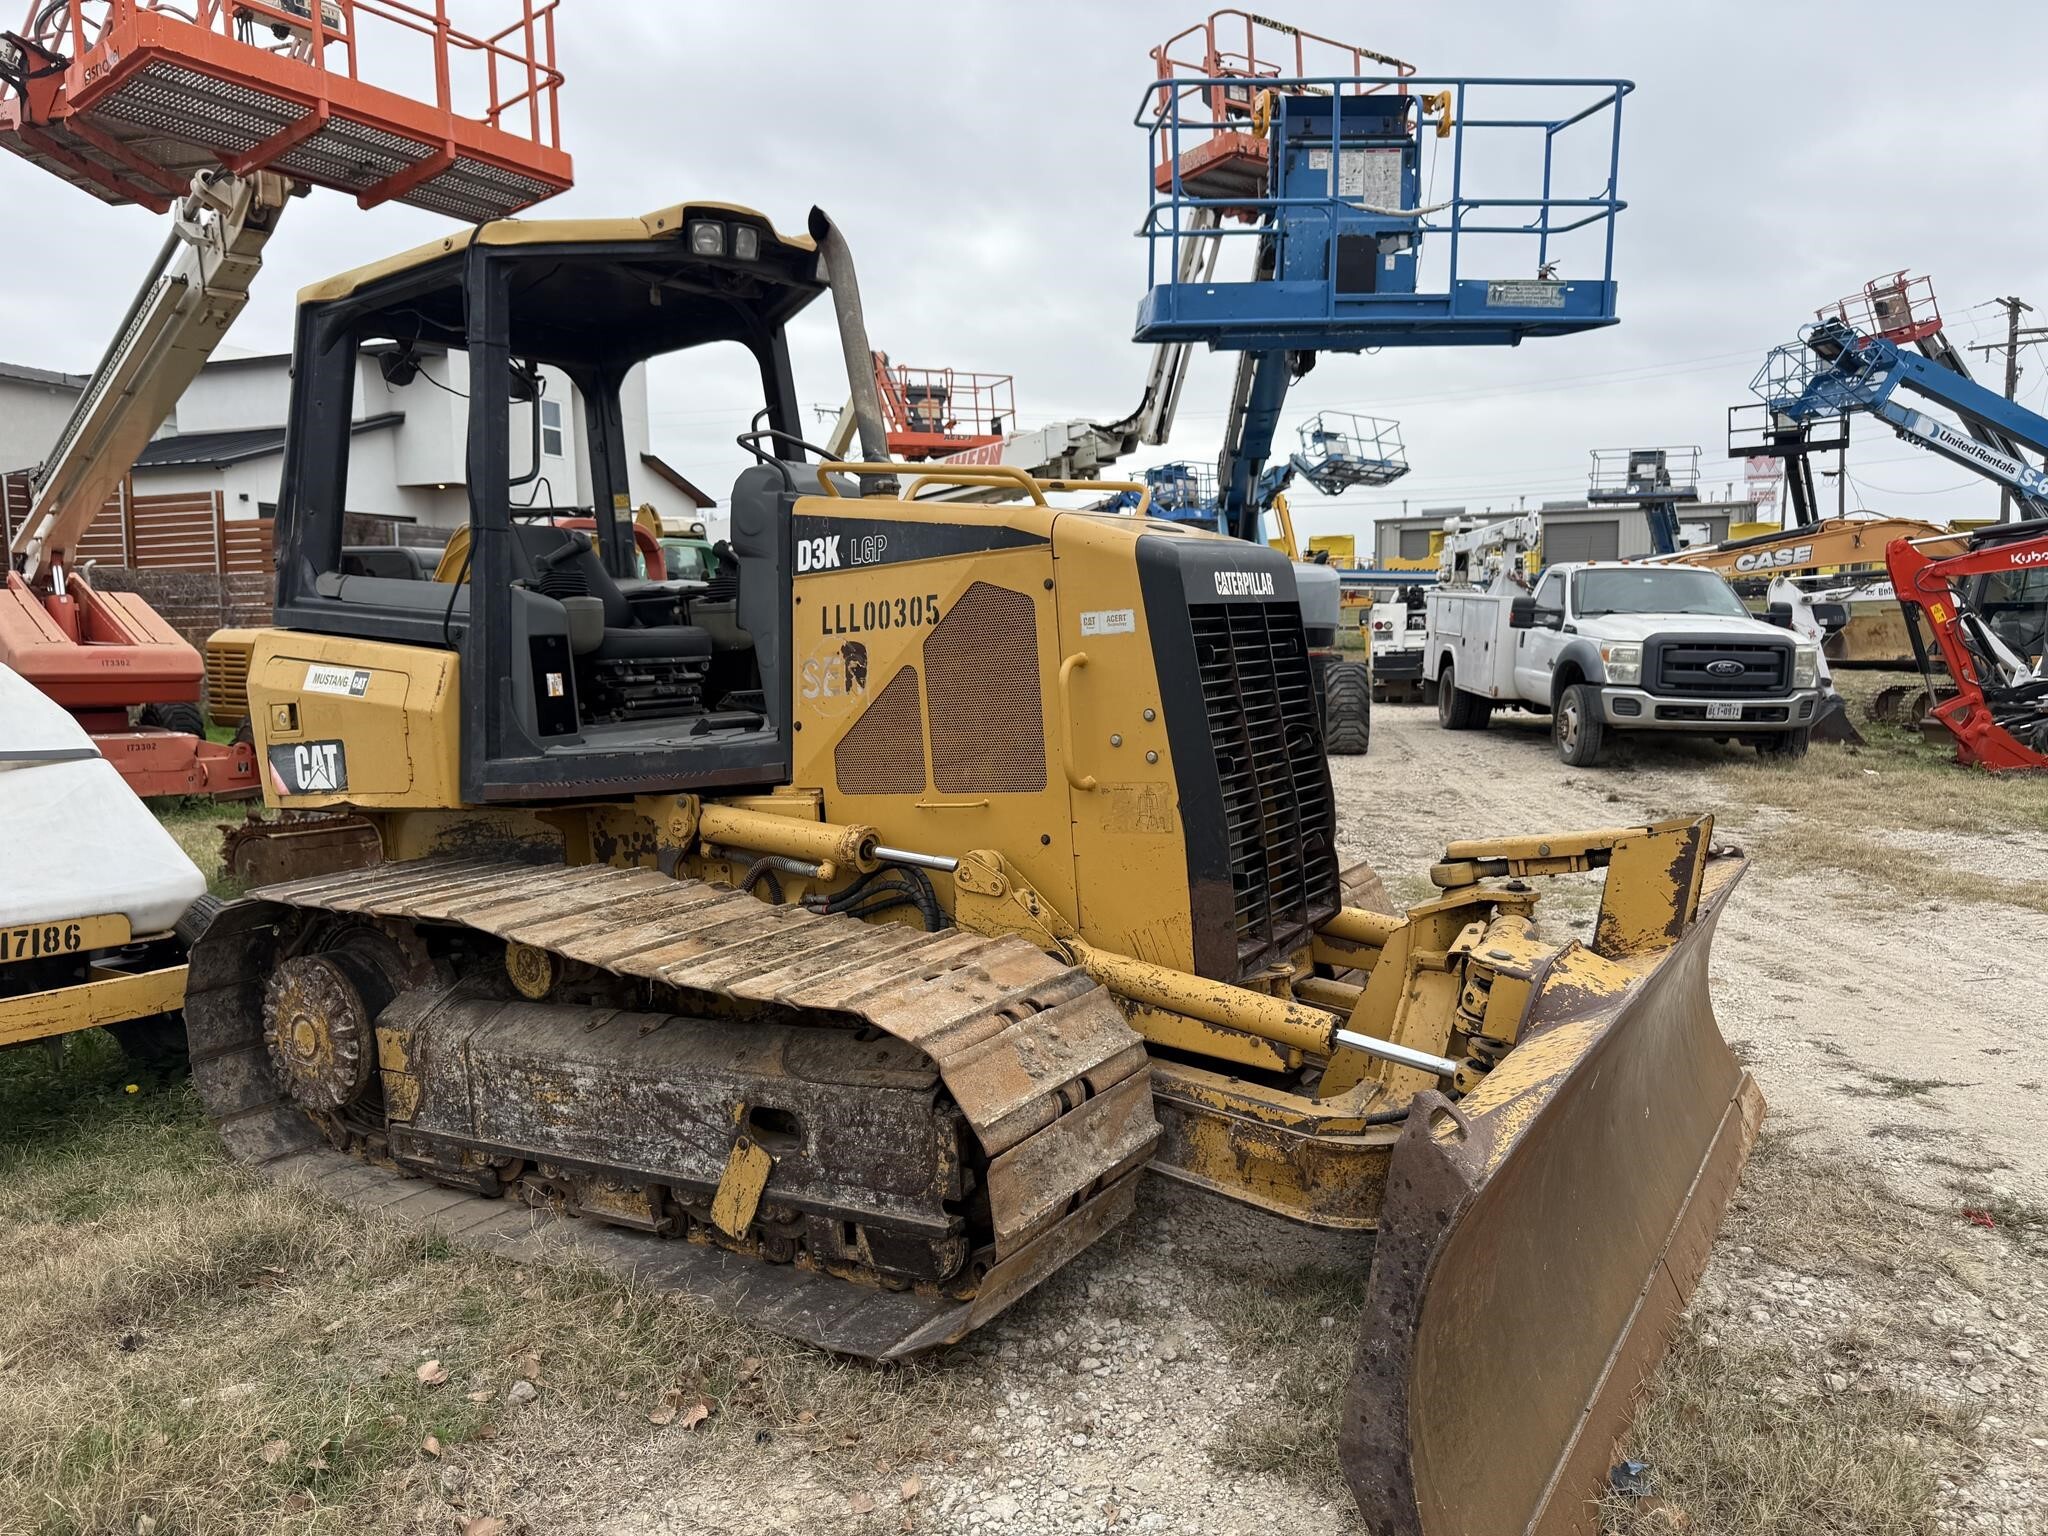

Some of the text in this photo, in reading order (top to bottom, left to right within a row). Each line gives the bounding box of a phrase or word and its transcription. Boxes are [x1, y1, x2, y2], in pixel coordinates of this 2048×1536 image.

[1939, 430, 2017, 475] United Rentals
[797, 534, 888, 572] D3K LGP
[1735, 545, 1812, 572] CASE
[1213, 571, 1275, 596] CATERPILLAR
[821, 594, 941, 636] LLL00305
[1083, 614, 1127, 626] CAT ACERT
[312, 673, 368, 691] MUSTANG CAT
[294, 744, 338, 790] CAT
